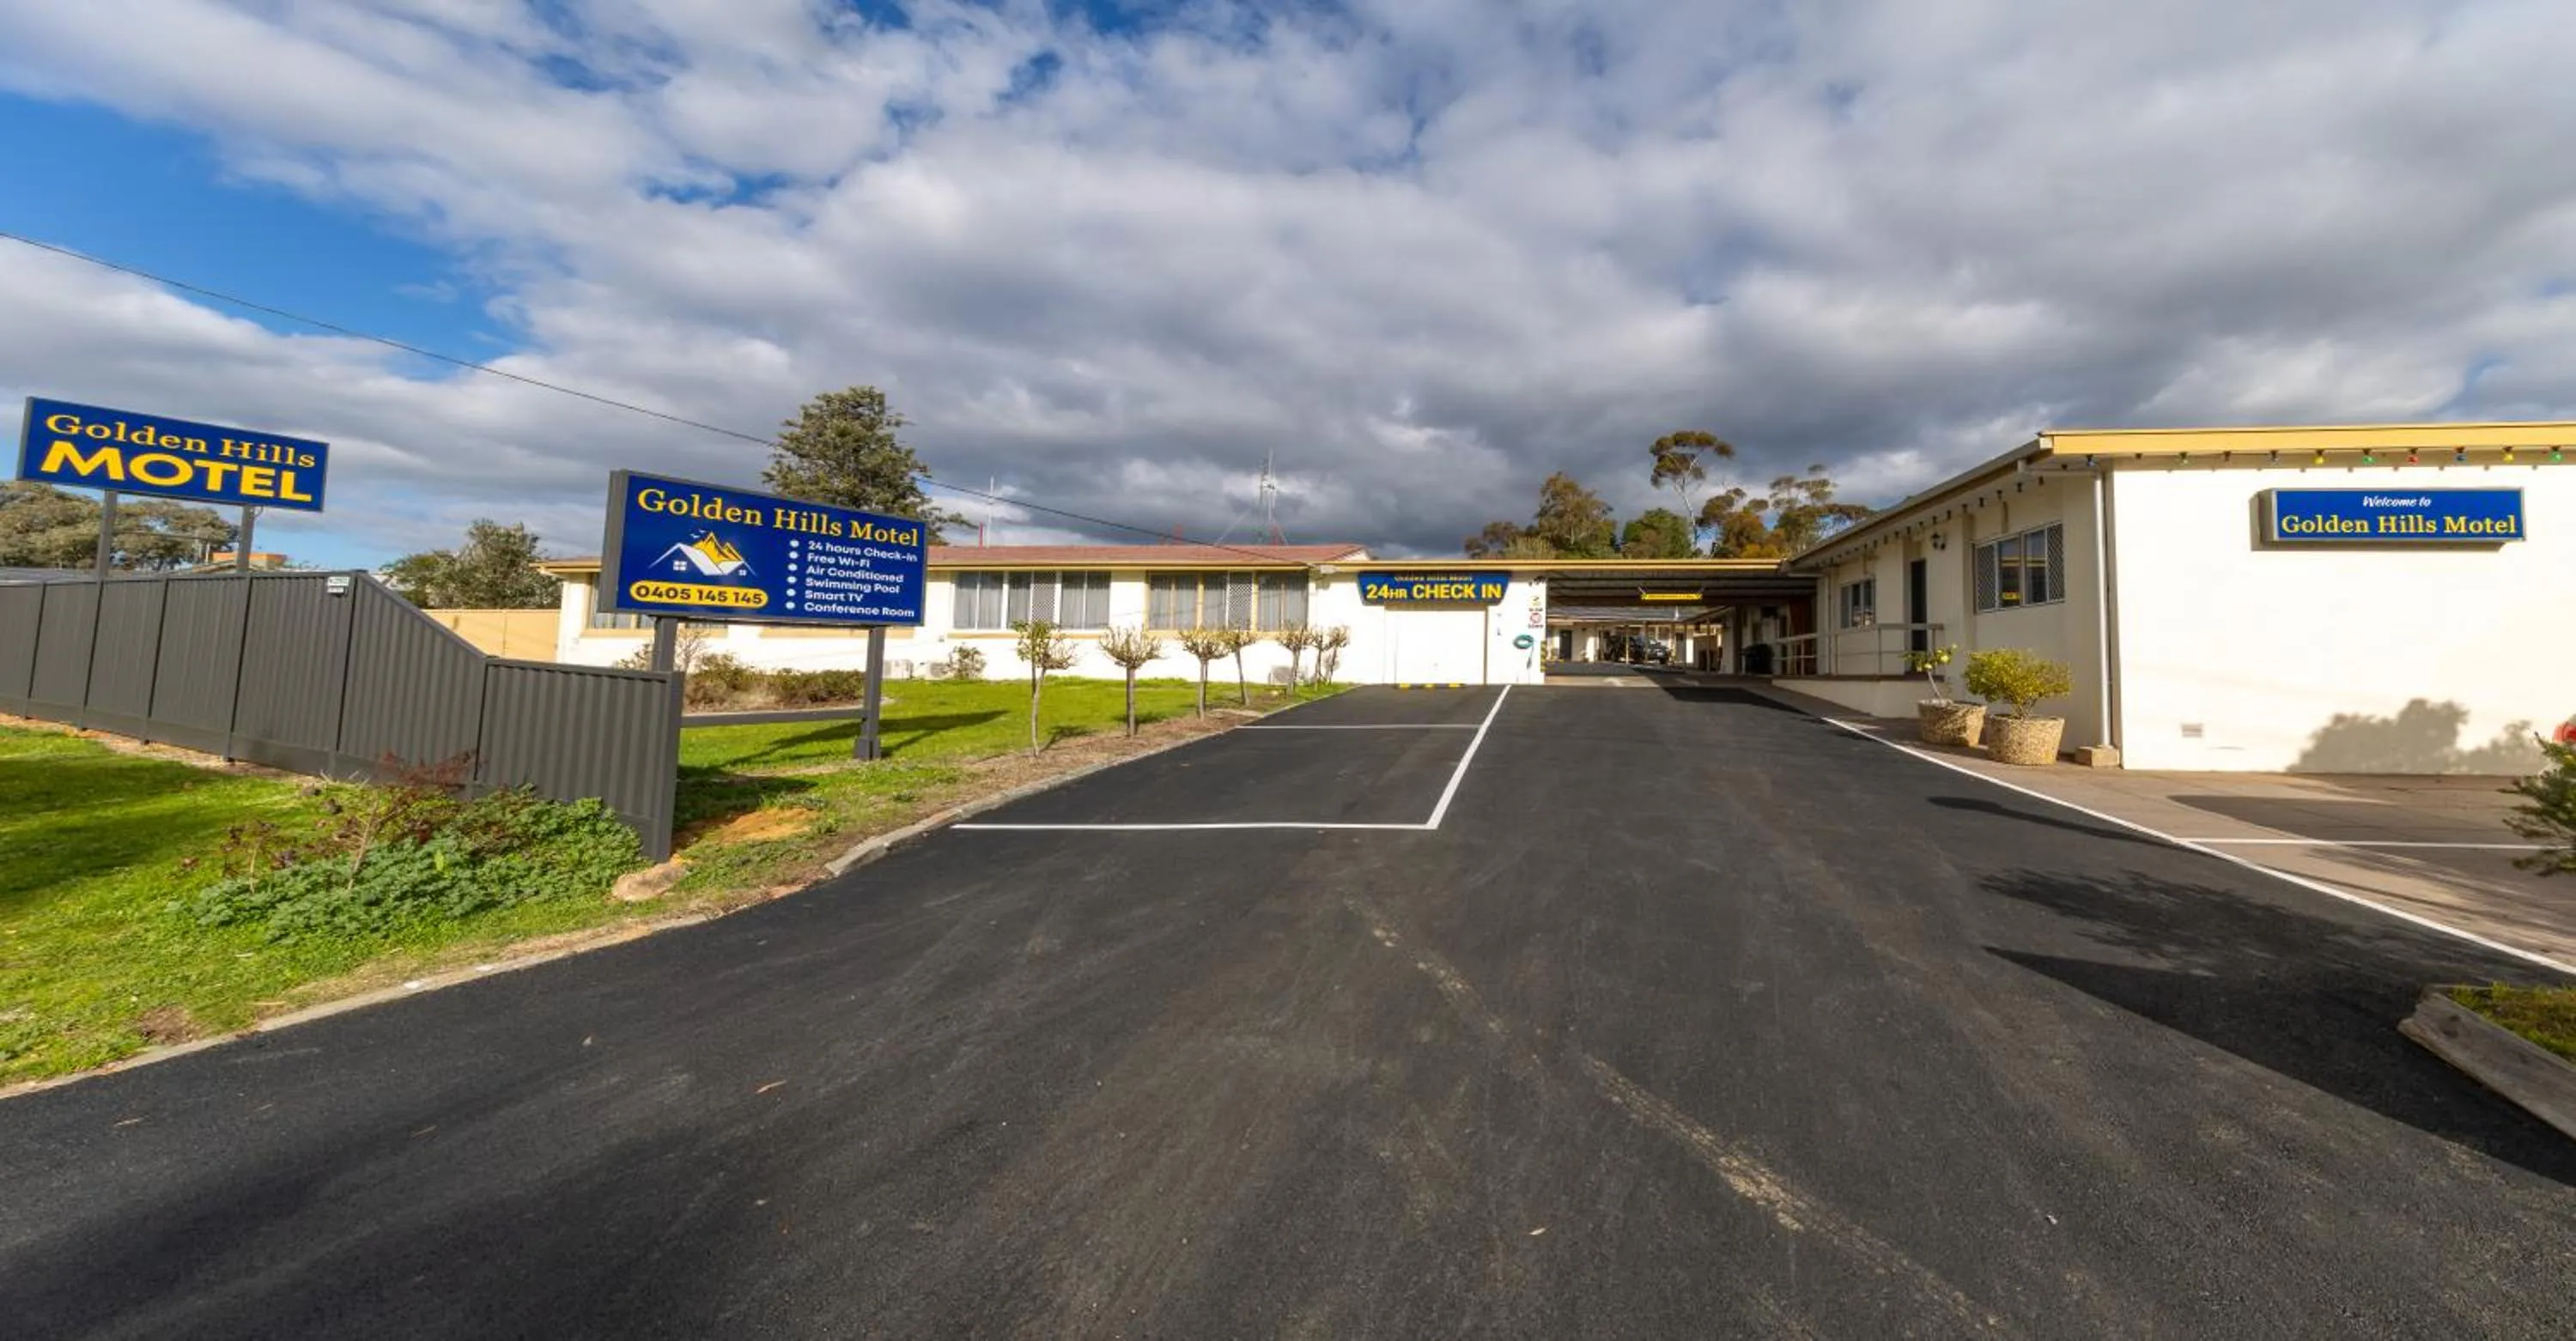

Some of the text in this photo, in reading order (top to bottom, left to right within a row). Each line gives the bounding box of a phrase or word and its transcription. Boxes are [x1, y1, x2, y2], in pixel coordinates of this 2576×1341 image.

[46, 414, 315, 468] Golden Hills
[40, 440, 312, 502] MOTEL
[2363, 495, 2432, 507] Welcome to
[637, 488, 918, 547] Golden Hills Motel
[2281, 514, 2517, 533] Golden Hills Motel
[807, 552, 835, 564] Free
[808, 541, 918, 562] 24 hours Check-in
[806, 566, 904, 582] Air Conditioned
[805, 577, 900, 593] Swimming Pool
[1413, 584, 1476, 599] CHECK
[1482, 584, 1502, 598] IN
[636, 586, 762, 604] 0405 145 145
[805, 590, 863, 602] Smart TV
[805, 602, 914, 617] Conference Room
